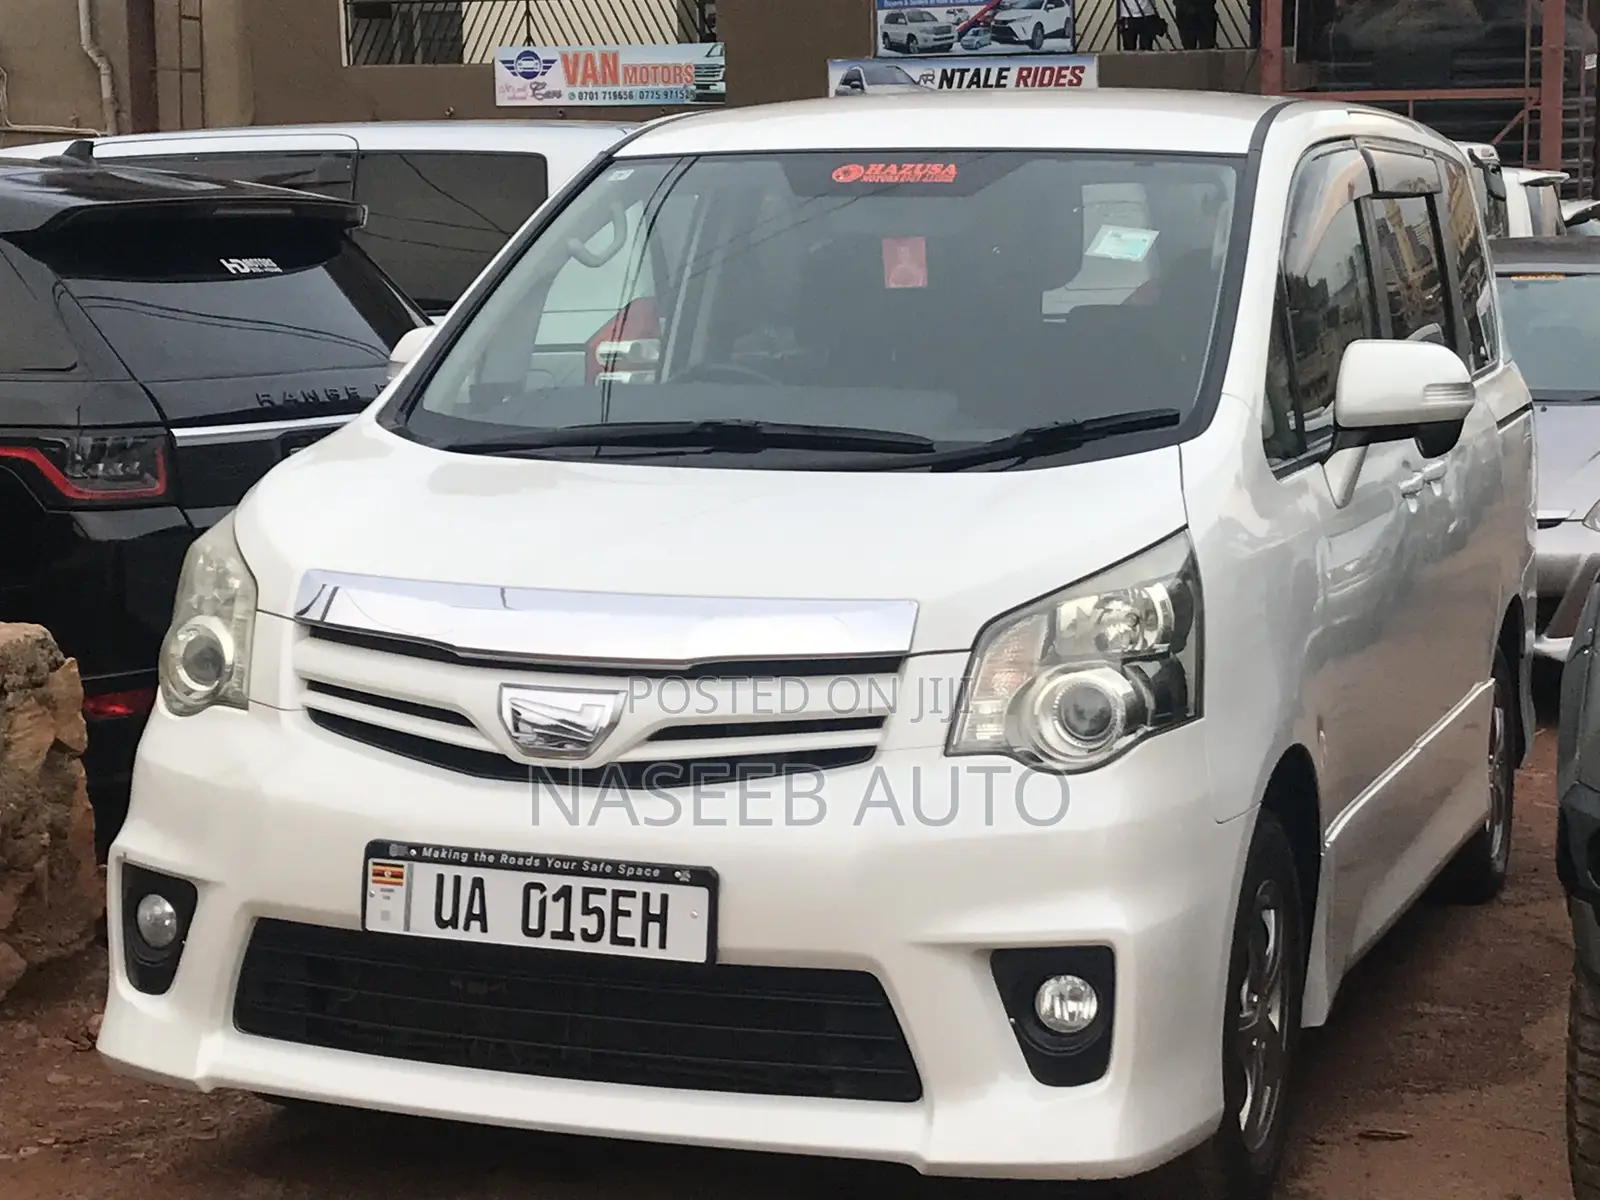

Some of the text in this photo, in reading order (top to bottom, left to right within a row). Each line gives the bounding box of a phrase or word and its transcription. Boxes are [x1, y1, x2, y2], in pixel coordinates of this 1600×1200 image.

[559, 51, 695, 87] VAN MOTORS
[937, 67, 1012, 90] NTALE
[1015, 66, 1086, 88] RIDES
[578, 91, 599, 101] 0701
[639, 90, 661, 100] 0775
[865, 163, 957, 176] HAZUSA
[422, 847, 469, 863] Making
[474, 852, 495, 863] the
[500, 853, 541, 867] Roads
[546, 857, 578, 870] Your
[581, 860, 613, 873] Safe
[618, 864, 660, 877] Space
[434, 872, 670, 950] UA 015EH
